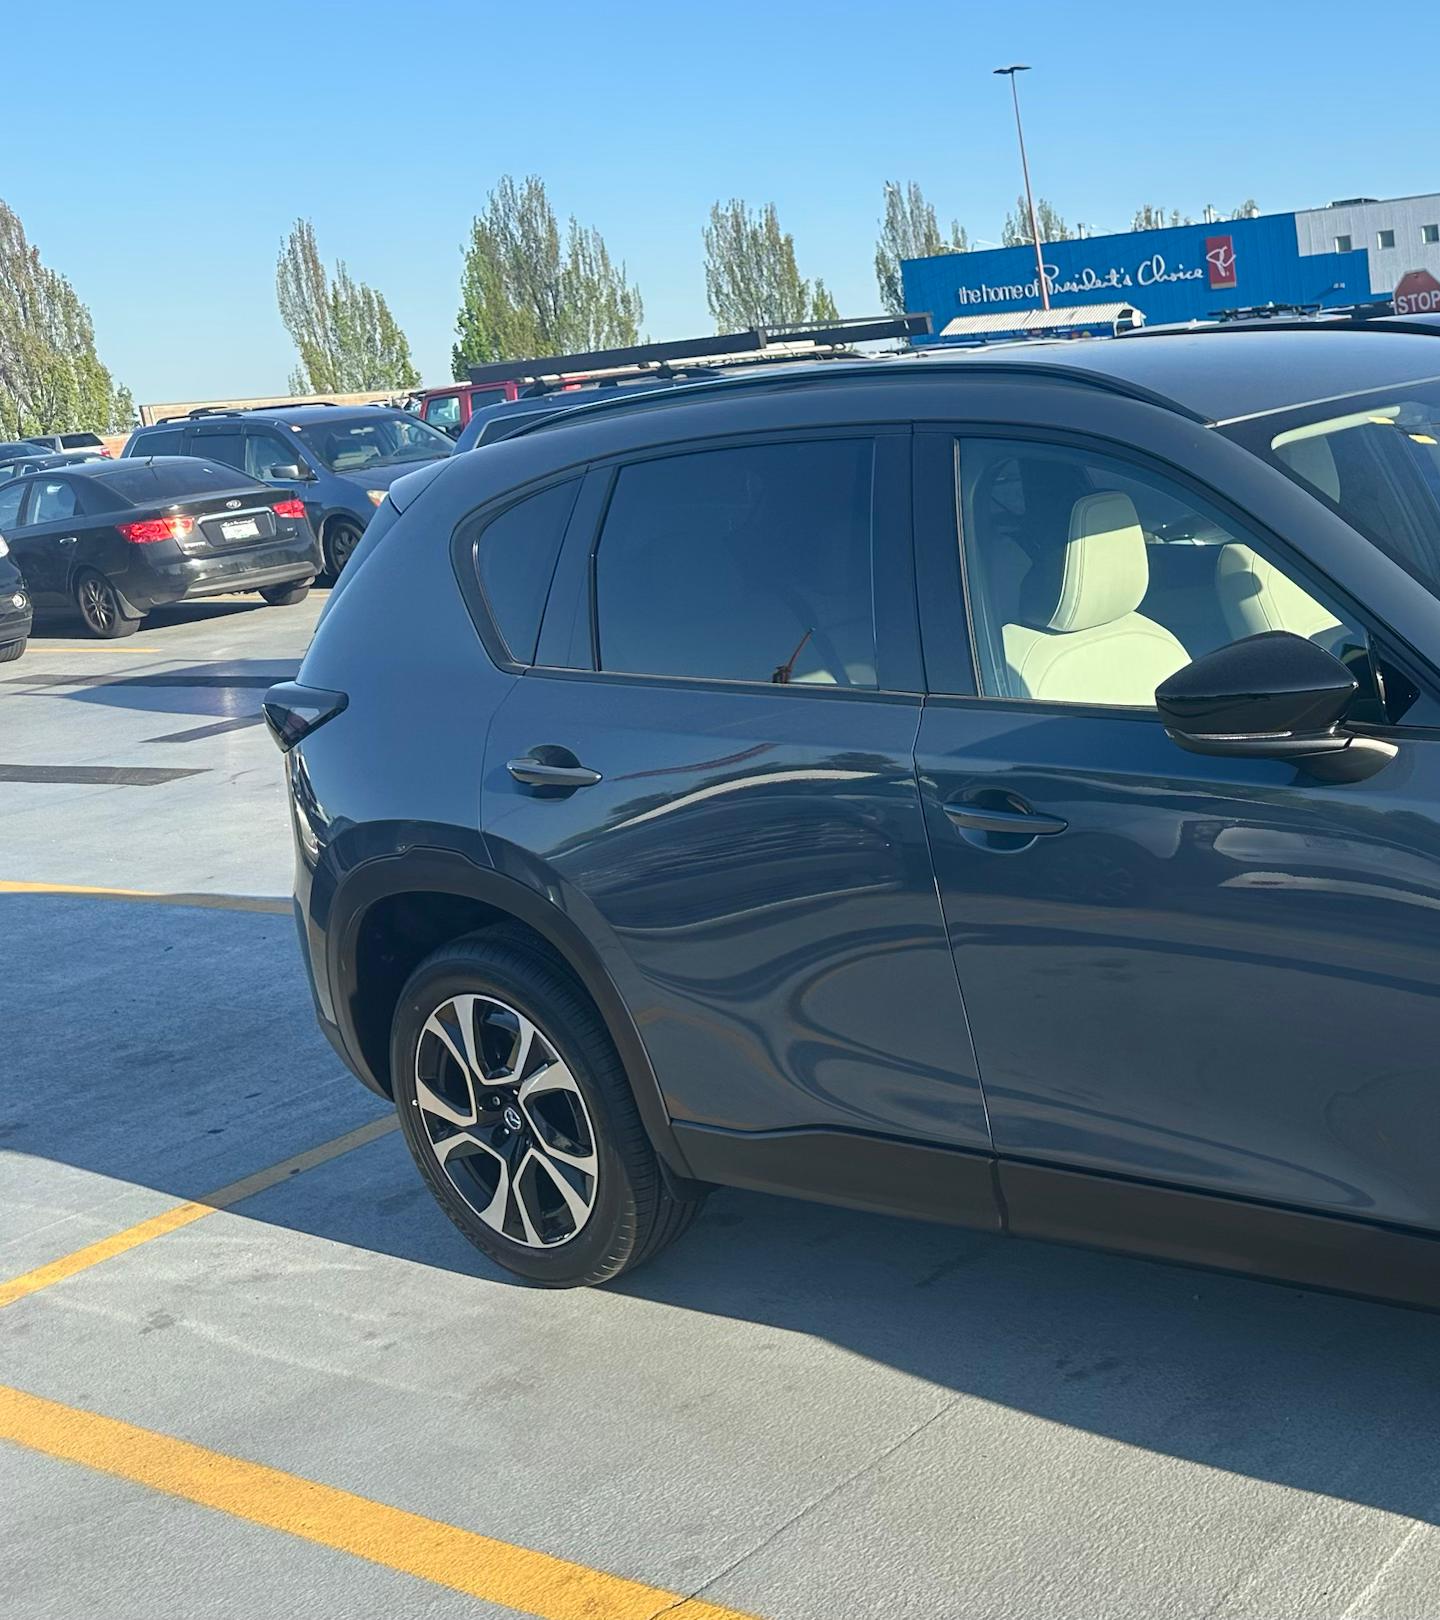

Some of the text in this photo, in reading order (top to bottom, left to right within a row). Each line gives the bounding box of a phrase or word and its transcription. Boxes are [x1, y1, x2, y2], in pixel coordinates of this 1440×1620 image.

[959, 254, 1204, 305] the home of President's Choice
